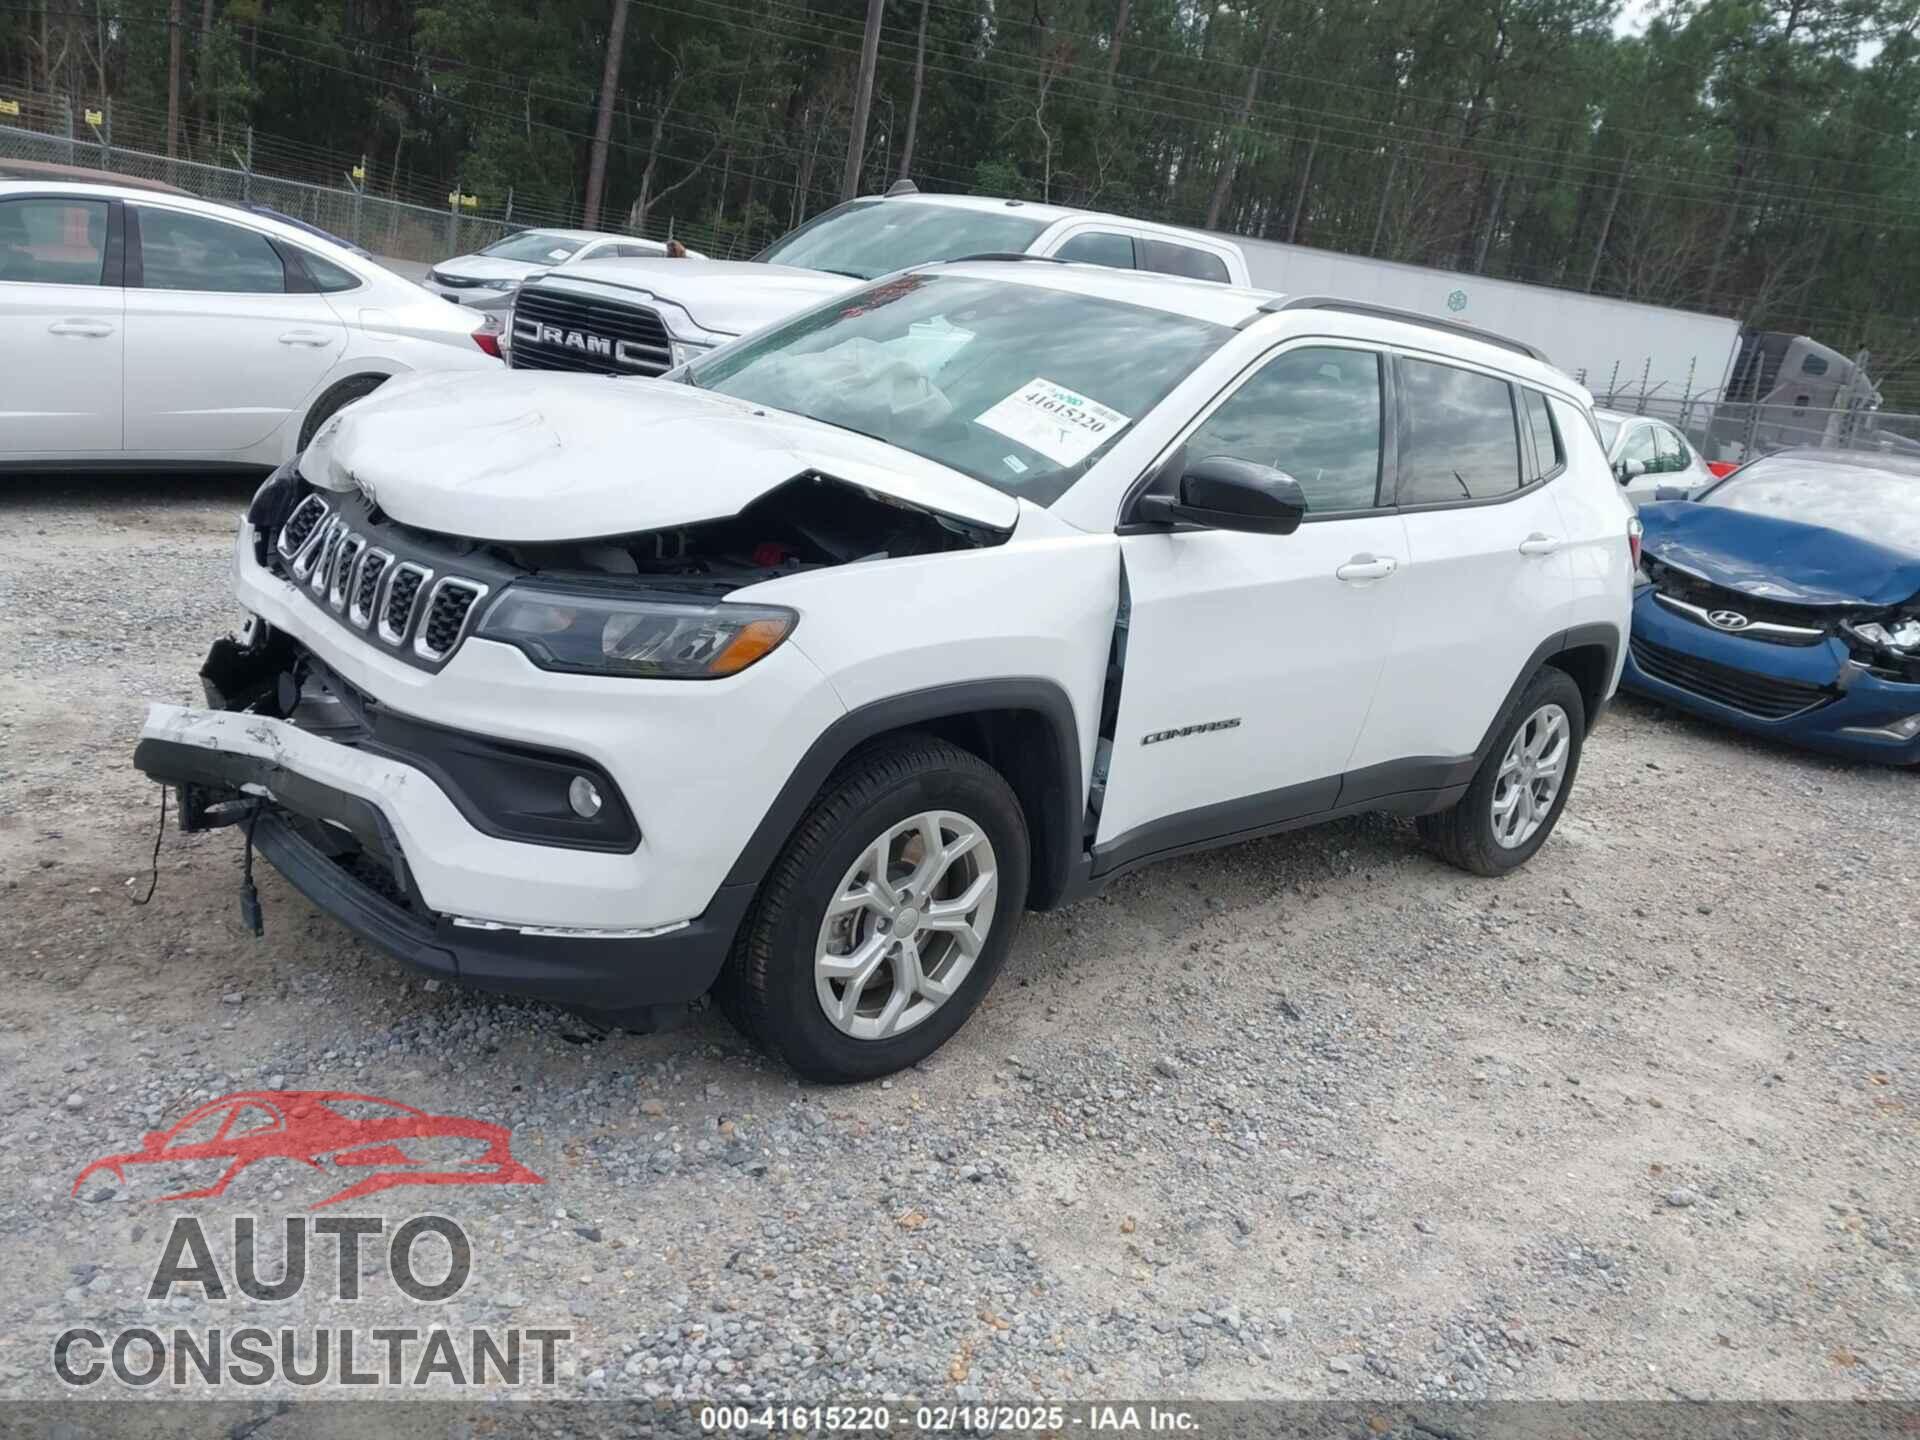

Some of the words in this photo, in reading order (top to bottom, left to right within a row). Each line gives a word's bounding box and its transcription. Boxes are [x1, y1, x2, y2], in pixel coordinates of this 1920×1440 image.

[543, 327, 611, 354] RAM
[1025, 392, 1105, 432] 41615220
[1141, 718, 1241, 745] COMPASS
